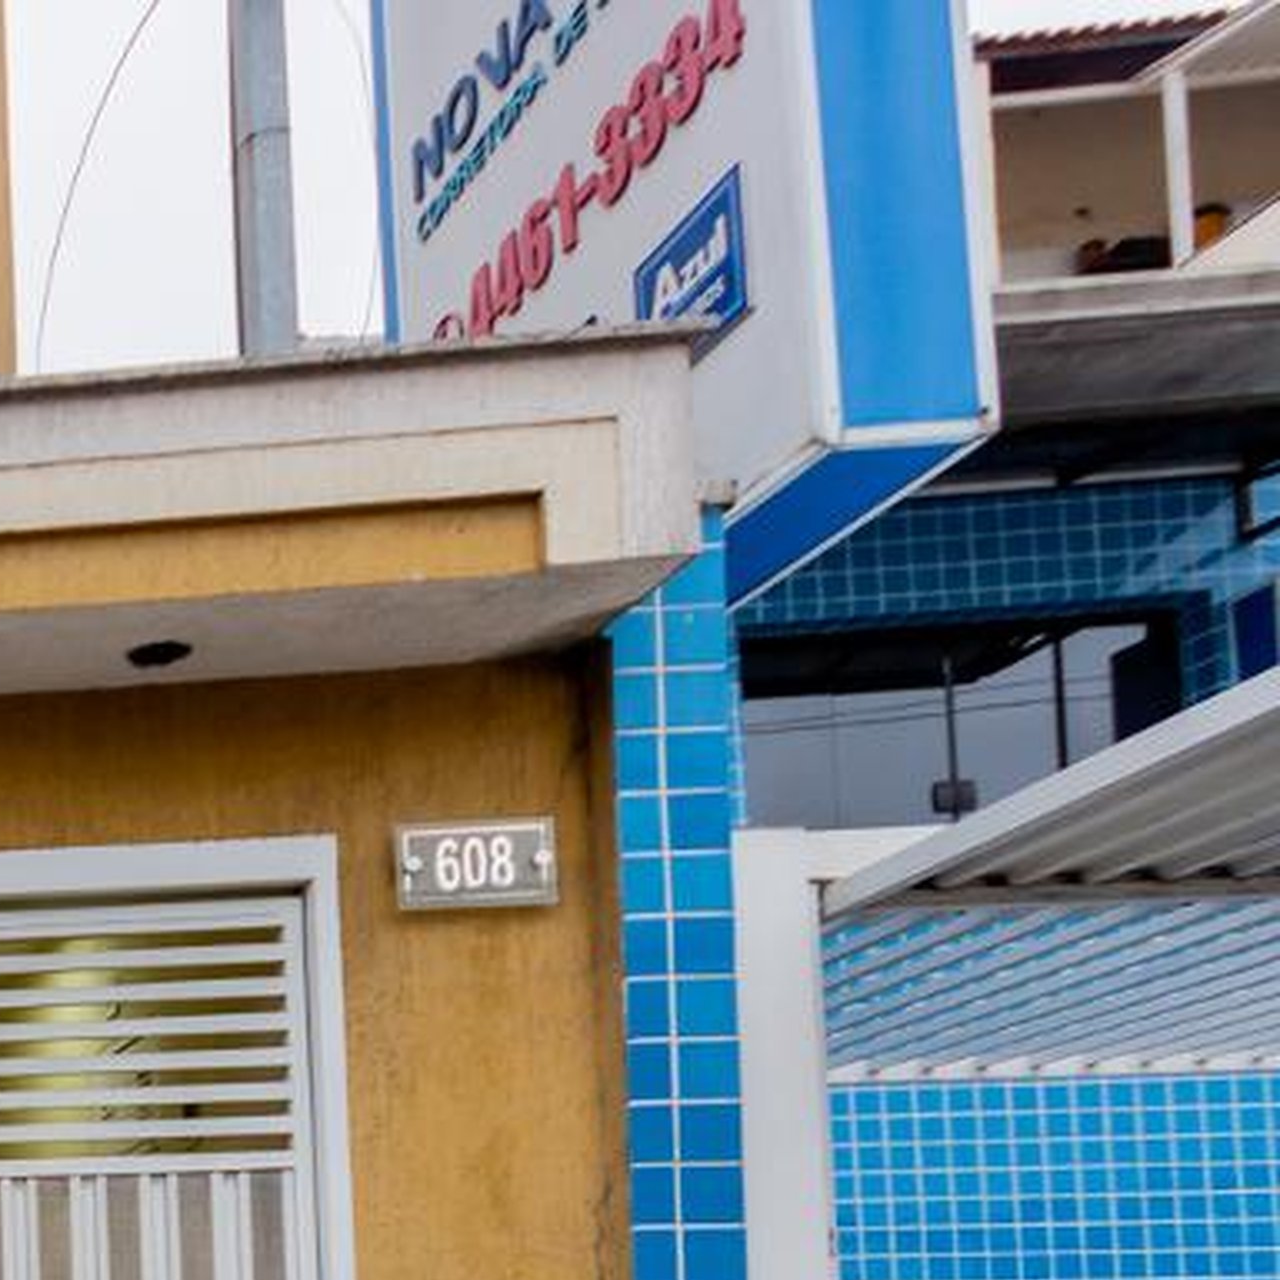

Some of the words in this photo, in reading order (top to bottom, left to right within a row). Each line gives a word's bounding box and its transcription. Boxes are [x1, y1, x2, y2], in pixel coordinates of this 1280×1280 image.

[554, 0, 588, 68] DE
[412, 0, 552, 203] NOVA
[436, 834, 515, 892] 608
